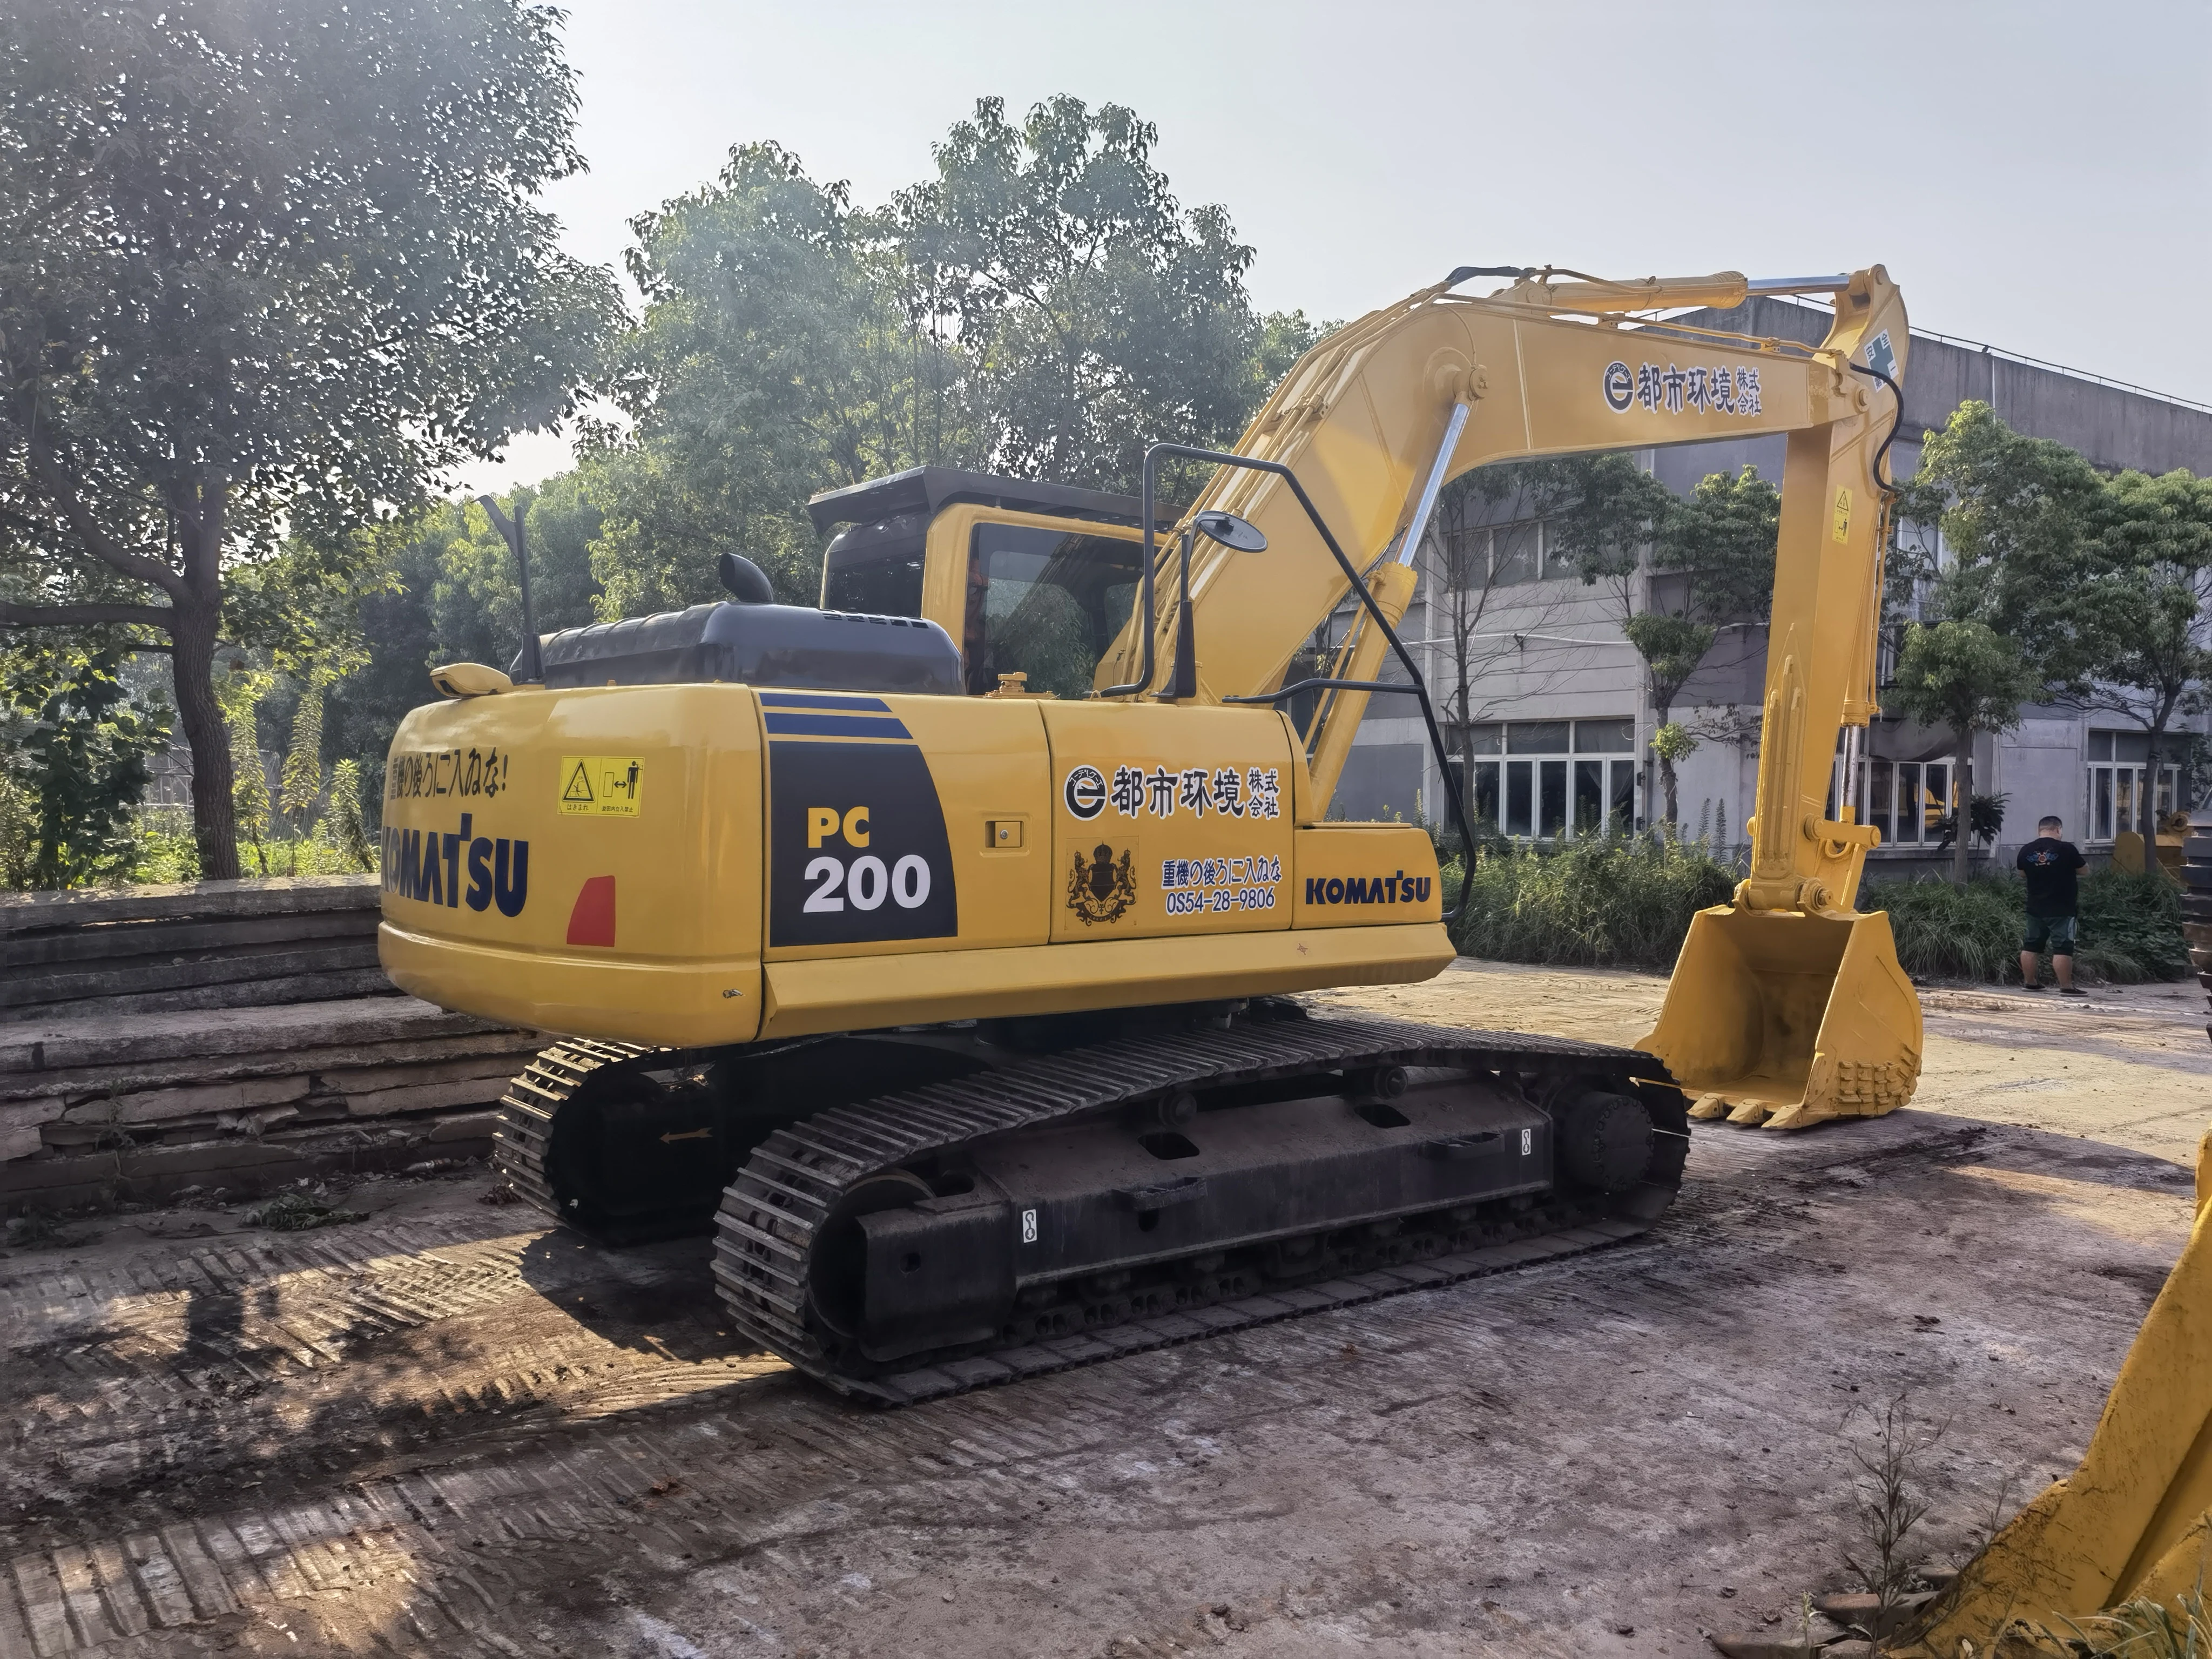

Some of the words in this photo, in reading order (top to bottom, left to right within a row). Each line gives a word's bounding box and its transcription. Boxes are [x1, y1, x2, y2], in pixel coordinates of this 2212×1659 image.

[807, 806, 869, 848] PC
[803, 854, 930, 913] 200
[1306, 870, 1431, 905] KOMATSU
